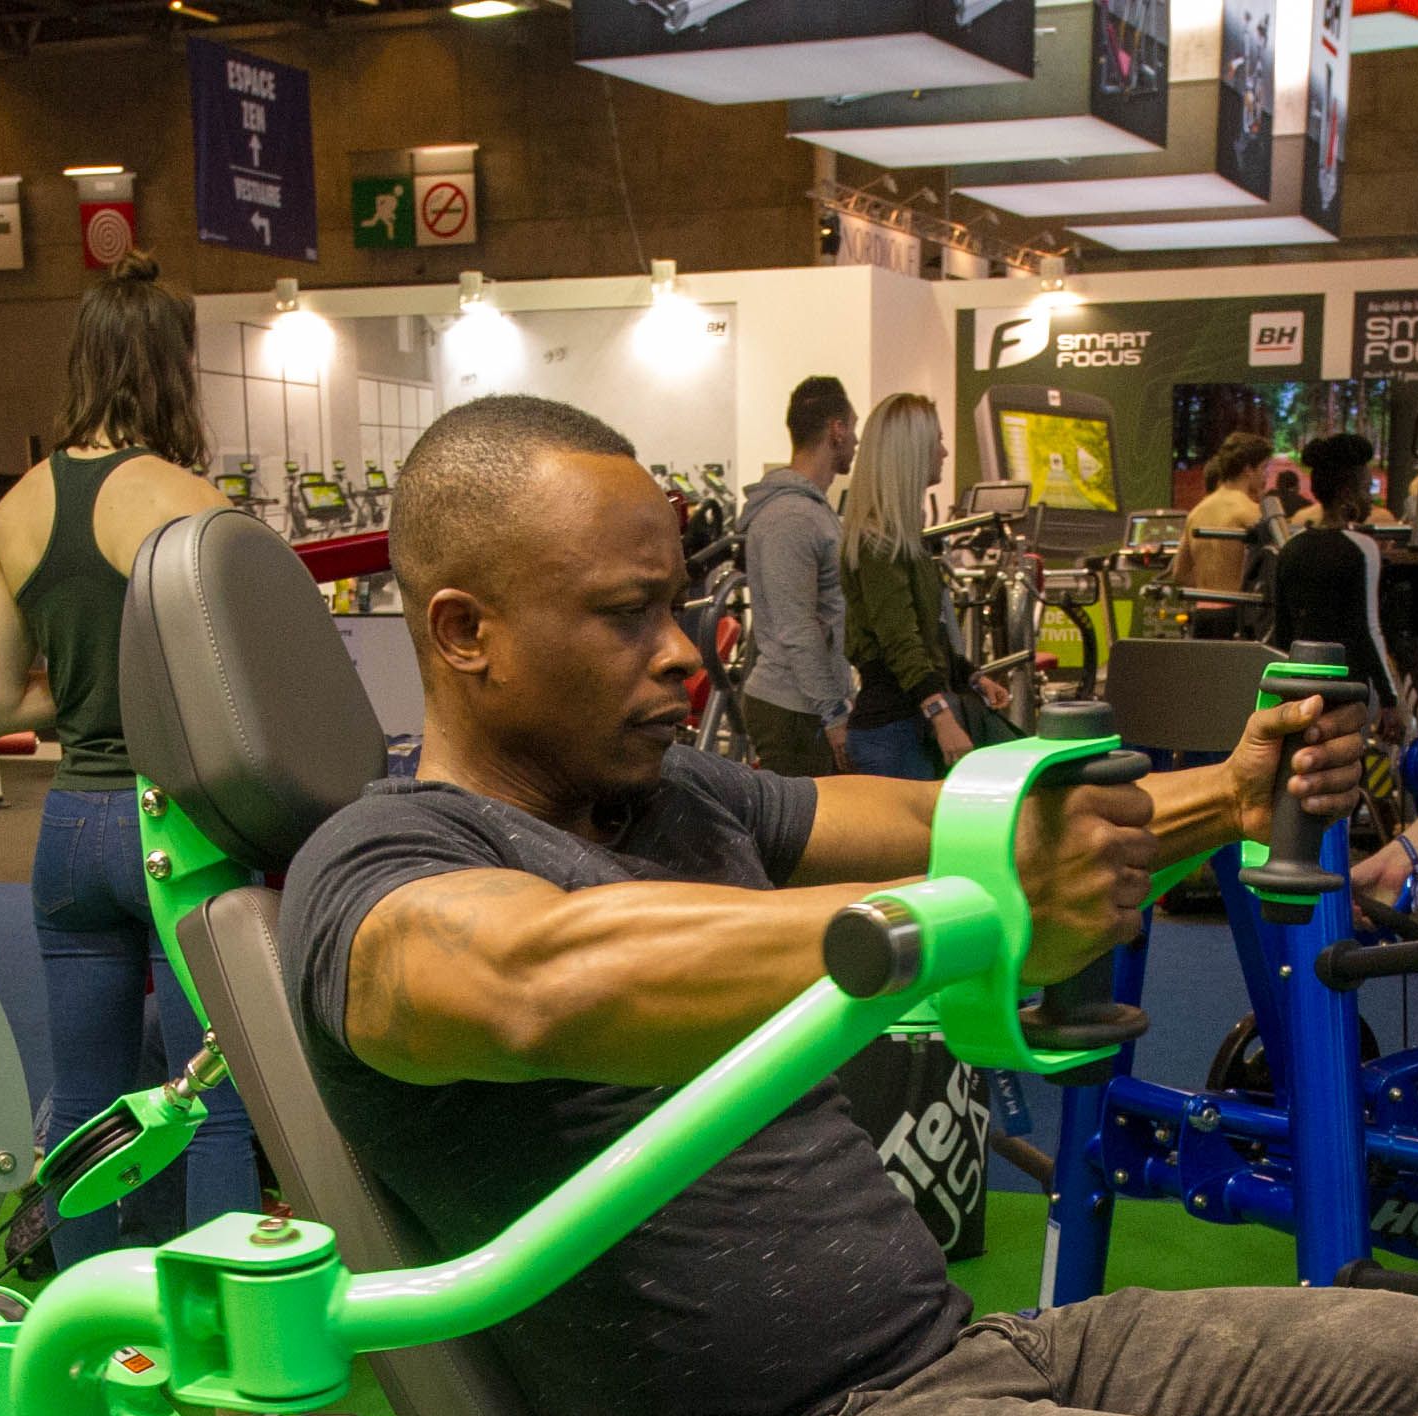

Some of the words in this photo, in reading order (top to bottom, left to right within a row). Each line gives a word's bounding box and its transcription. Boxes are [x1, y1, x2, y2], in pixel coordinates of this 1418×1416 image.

[227, 59, 276, 100] ESPACE
[241, 100, 266, 133] ZEN
[1056, 331, 1152, 351] SMART
[1257, 326, 1297, 346] BH
[1056, 350, 1142, 368] FOCUS
